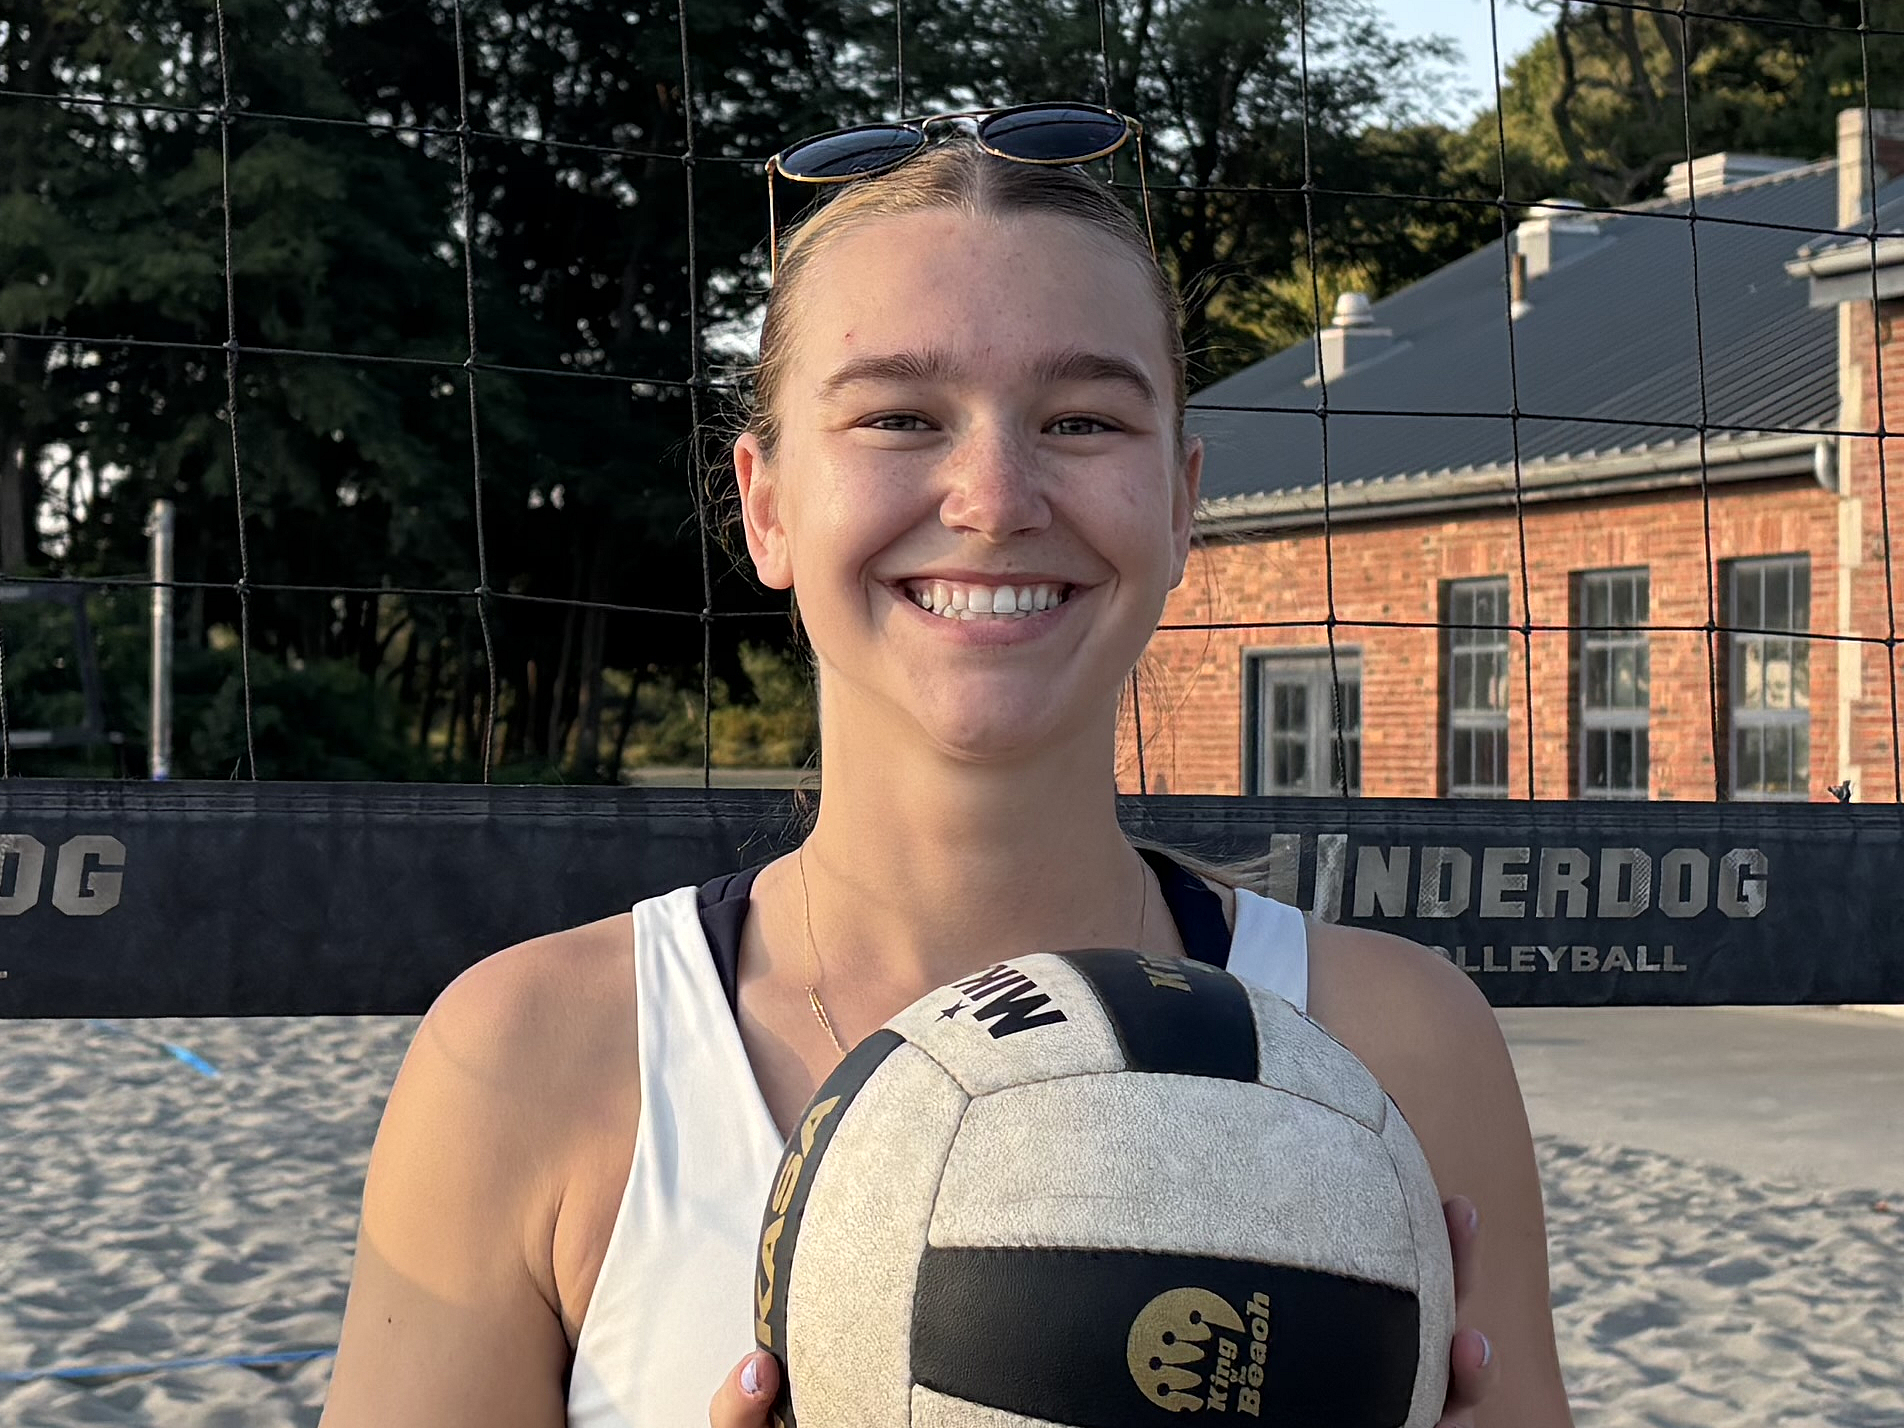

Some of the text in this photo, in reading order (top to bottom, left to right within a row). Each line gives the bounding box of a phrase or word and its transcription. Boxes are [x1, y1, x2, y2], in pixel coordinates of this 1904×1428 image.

[1268, 833, 1768, 925] UNDERDOG
[1426, 945, 1688, 972] LLEYBALL
[1206, 1327, 1239, 1412] King
